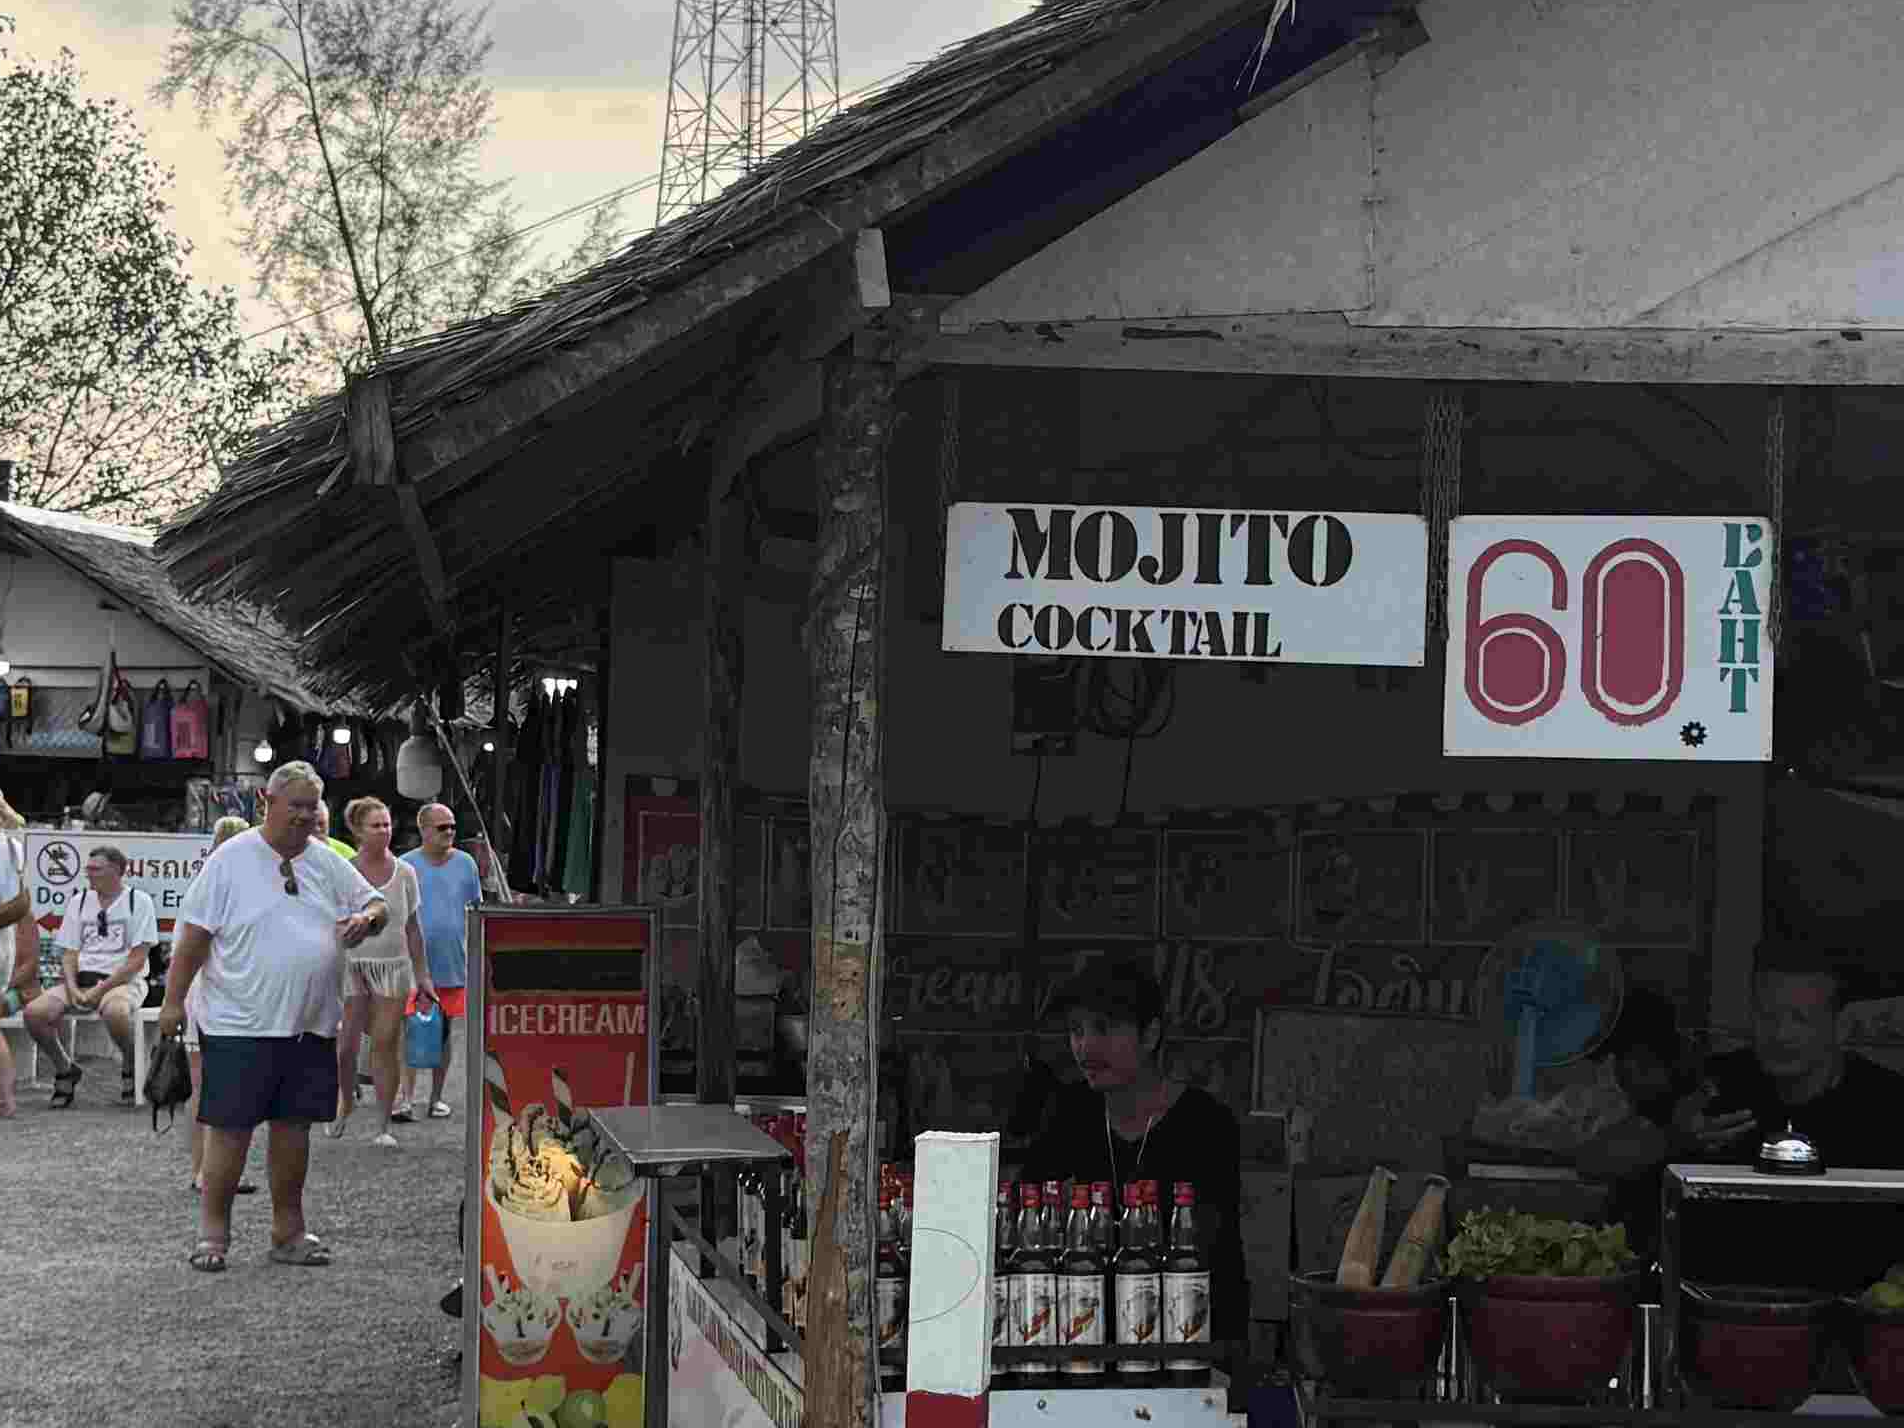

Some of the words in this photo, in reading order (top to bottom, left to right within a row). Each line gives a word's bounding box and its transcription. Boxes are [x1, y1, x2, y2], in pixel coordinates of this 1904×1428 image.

[1005, 507, 1354, 588] MOJITO
[997, 603, 1283, 659] COCKTAIL
[1717, 522, 1762, 713] BAHT
[37, 887, 65, 905] Do
[489, 1003, 646, 1036] ICECREAM
